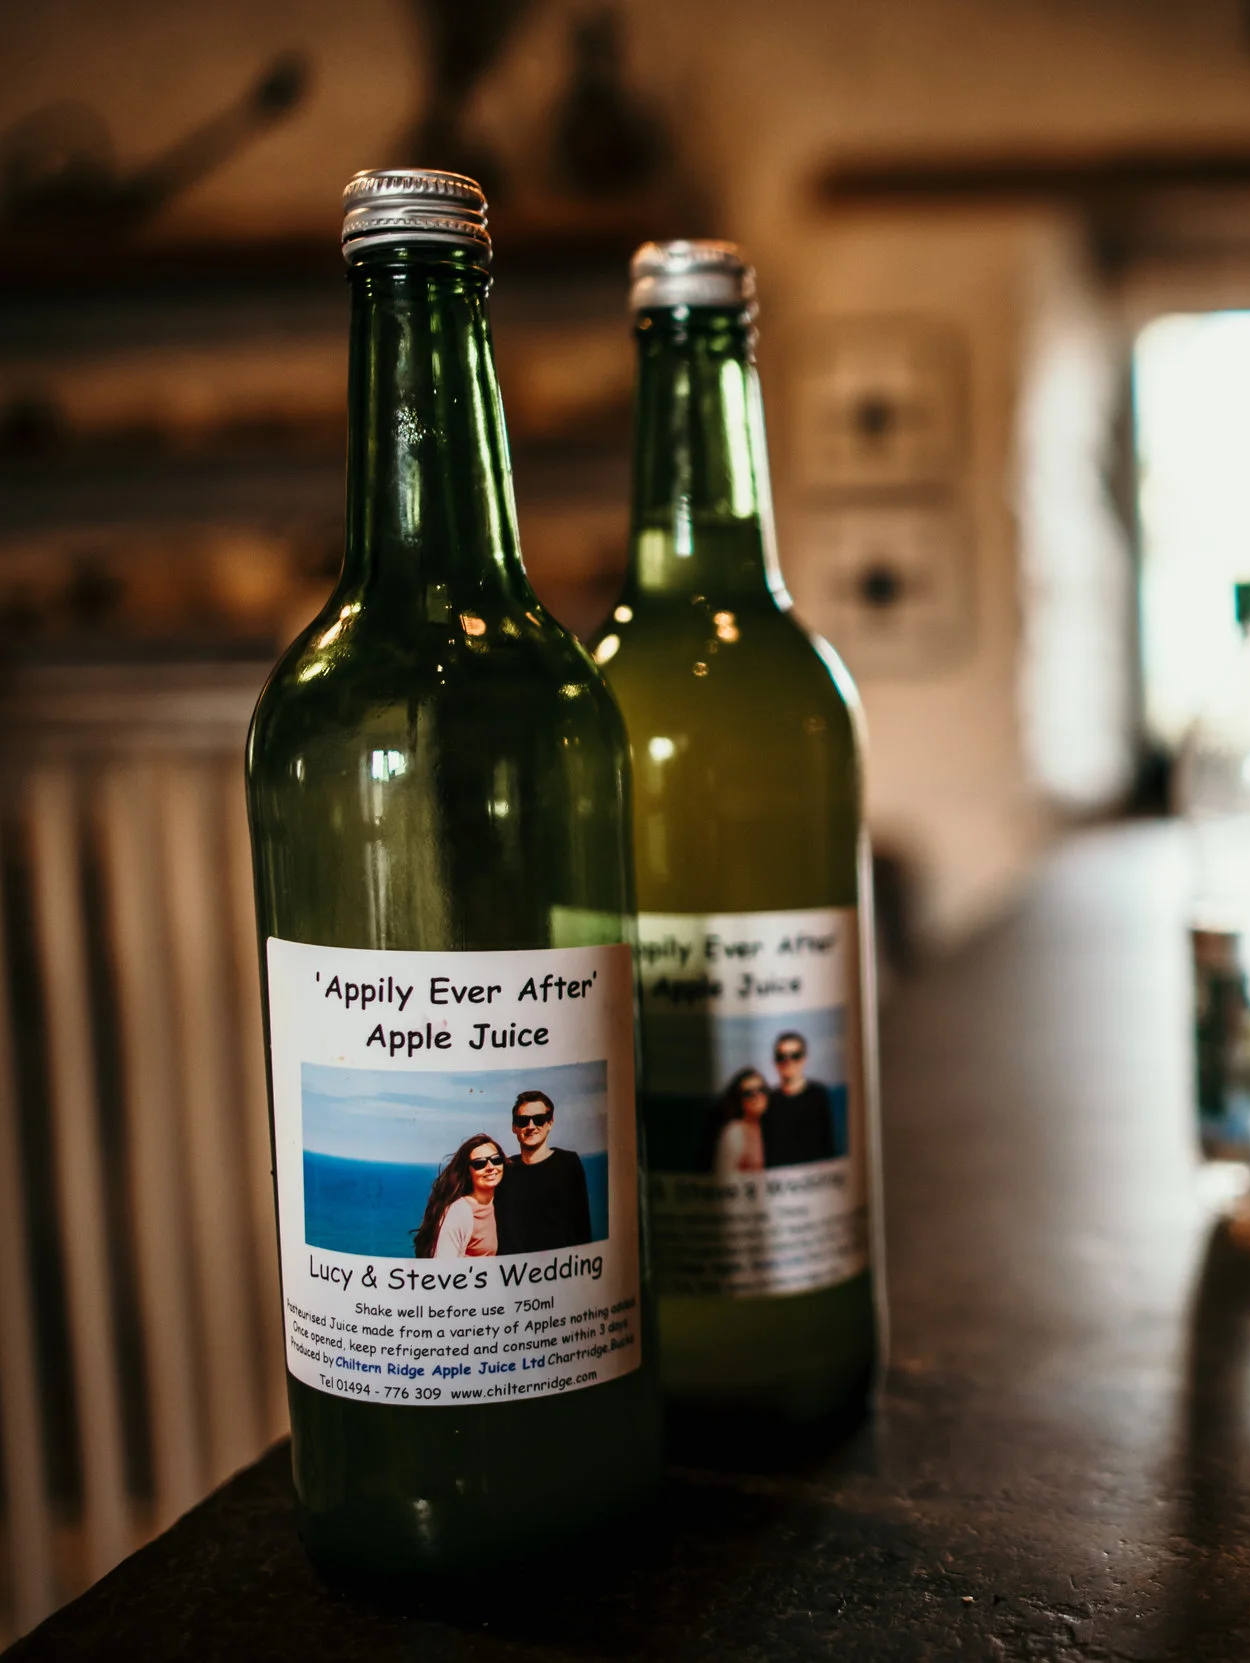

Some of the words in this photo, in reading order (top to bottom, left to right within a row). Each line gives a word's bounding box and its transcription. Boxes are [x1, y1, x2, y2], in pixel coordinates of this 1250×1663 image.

[316, 971, 413, 1011] 'Appily
[430, 977, 502, 1004] Ever
[518, 971, 597, 1002] After'
[366, 1022, 452, 1057] Apple
[469, 1022, 550, 1050] Juice
[309, 1254, 353, 1291] Lucy
[361, 1265, 378, 1288] &
[388, 1266, 488, 1290] Steve's
[499, 1254, 603, 1287] Wedding
[329, 1316, 358, 1333] Juice
[362, 1325, 394, 1337] made
[399, 1326, 433, 1338] from
[437, 1329, 445, 1338] a
[450, 1324, 499, 1338] variety
[504, 1322, 520, 1335] of
[524, 1316, 566, 1334] Apples
[570, 1307, 609, 1324] nothing
[355, 1303, 393, 1317] Shake
[397, 1306, 423, 1318] well
[428, 1306, 477, 1318] before
[482, 1305, 505, 1316] use
[514, 1296, 554, 1313] 750ml
[290, 1336, 321, 1361] Produced
[323, 1354, 335, 1367] by
[335, 1356, 382, 1374] Chiltern
[387, 1362, 425, 1379] Ridge
[432, 1363, 471, 1379] Apple
[478, 1361, 516, 1375] Juice
[522, 1355, 546, 1370] Ltd
[293, 1320, 309, 1338] Once
[311, 1331, 346, 1351] opened,
[349, 1339, 377, 1357] keep
[380, 1343, 469, 1360] refrigerated
[473, 1342, 498, 1355] and
[503, 1337, 558, 1353] consume
[561, 1328, 596, 1344] within
[599, 1323, 606, 1336] 3
[319, 1373, 334, 1389] Tel
[336, 1379, 371, 1396] 01494
[384, 1386, 409, 1399] 776
[415, 1388, 441, 1400] 309
[451, 1370, 598, 1399] www.chilternridge.com
